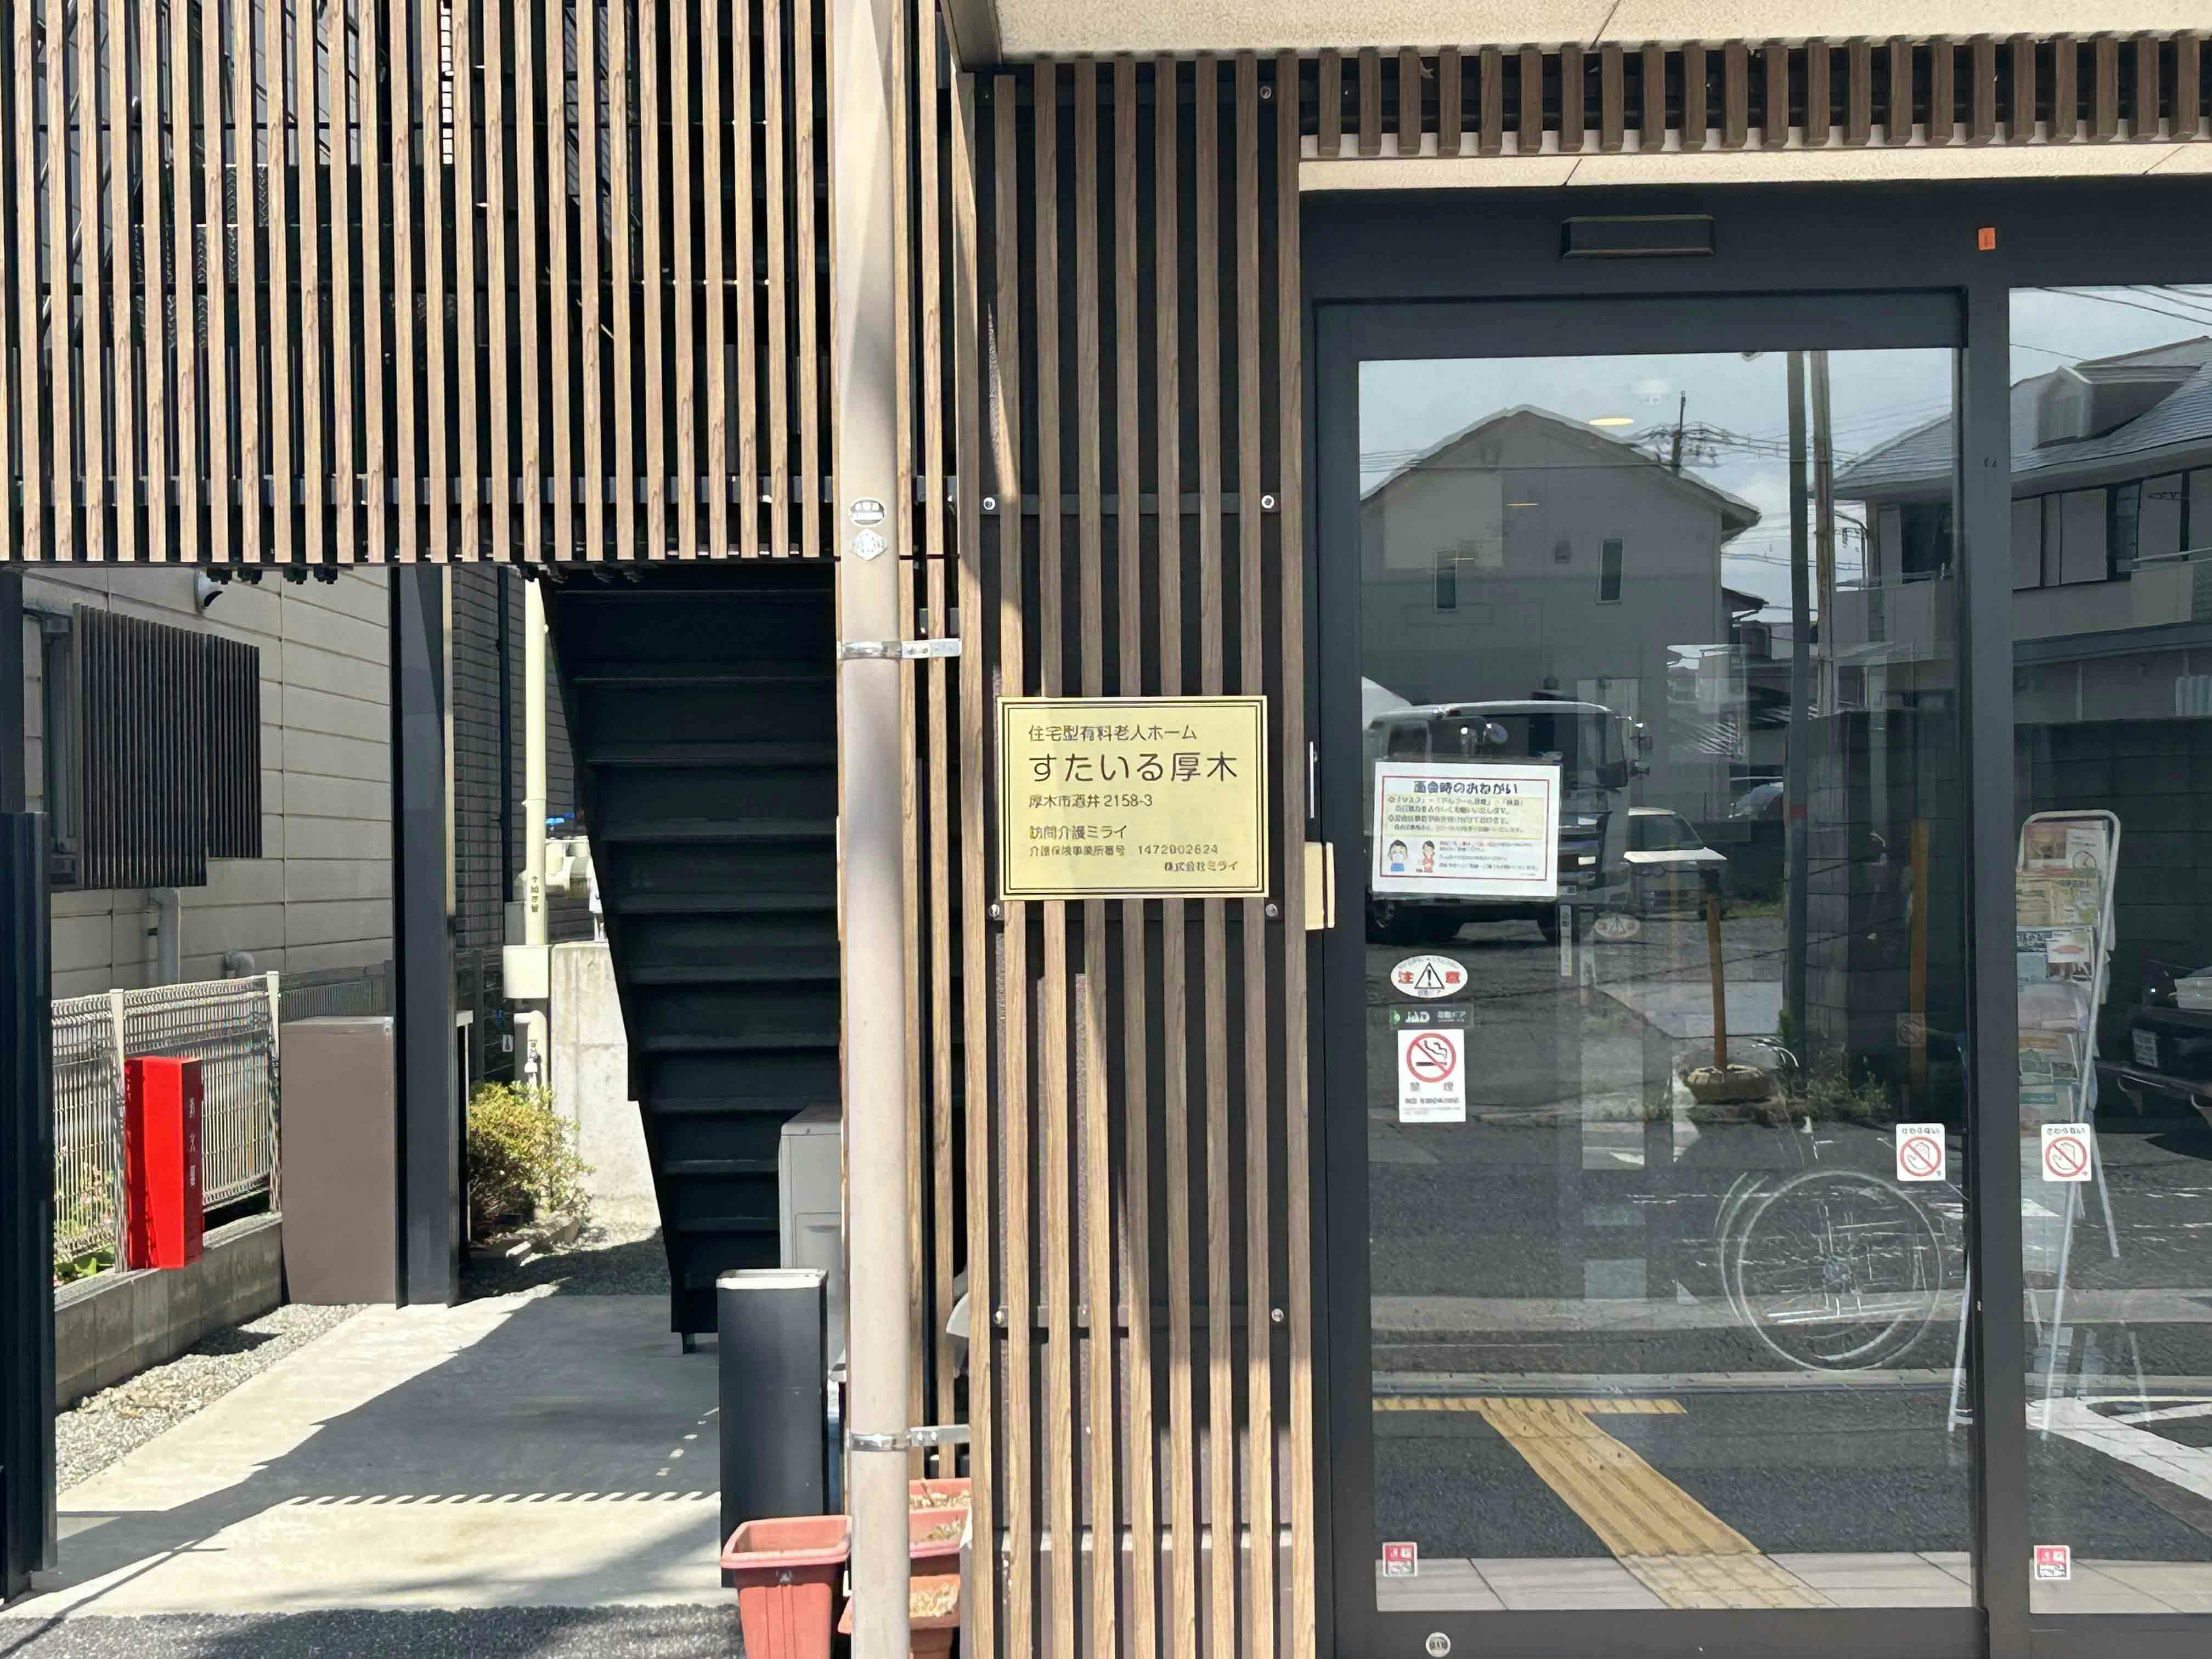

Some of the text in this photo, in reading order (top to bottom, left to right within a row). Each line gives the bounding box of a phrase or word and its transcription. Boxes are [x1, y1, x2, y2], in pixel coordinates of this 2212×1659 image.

[1029, 725, 1197, 742] 住宅型有料老人ホーム
[1029, 752, 1238, 782] すたいる厚木
[1030, 825, 1127, 840] 訪問介護ミライ
[1164, 861, 1238, 872] 株式会社ミライ
